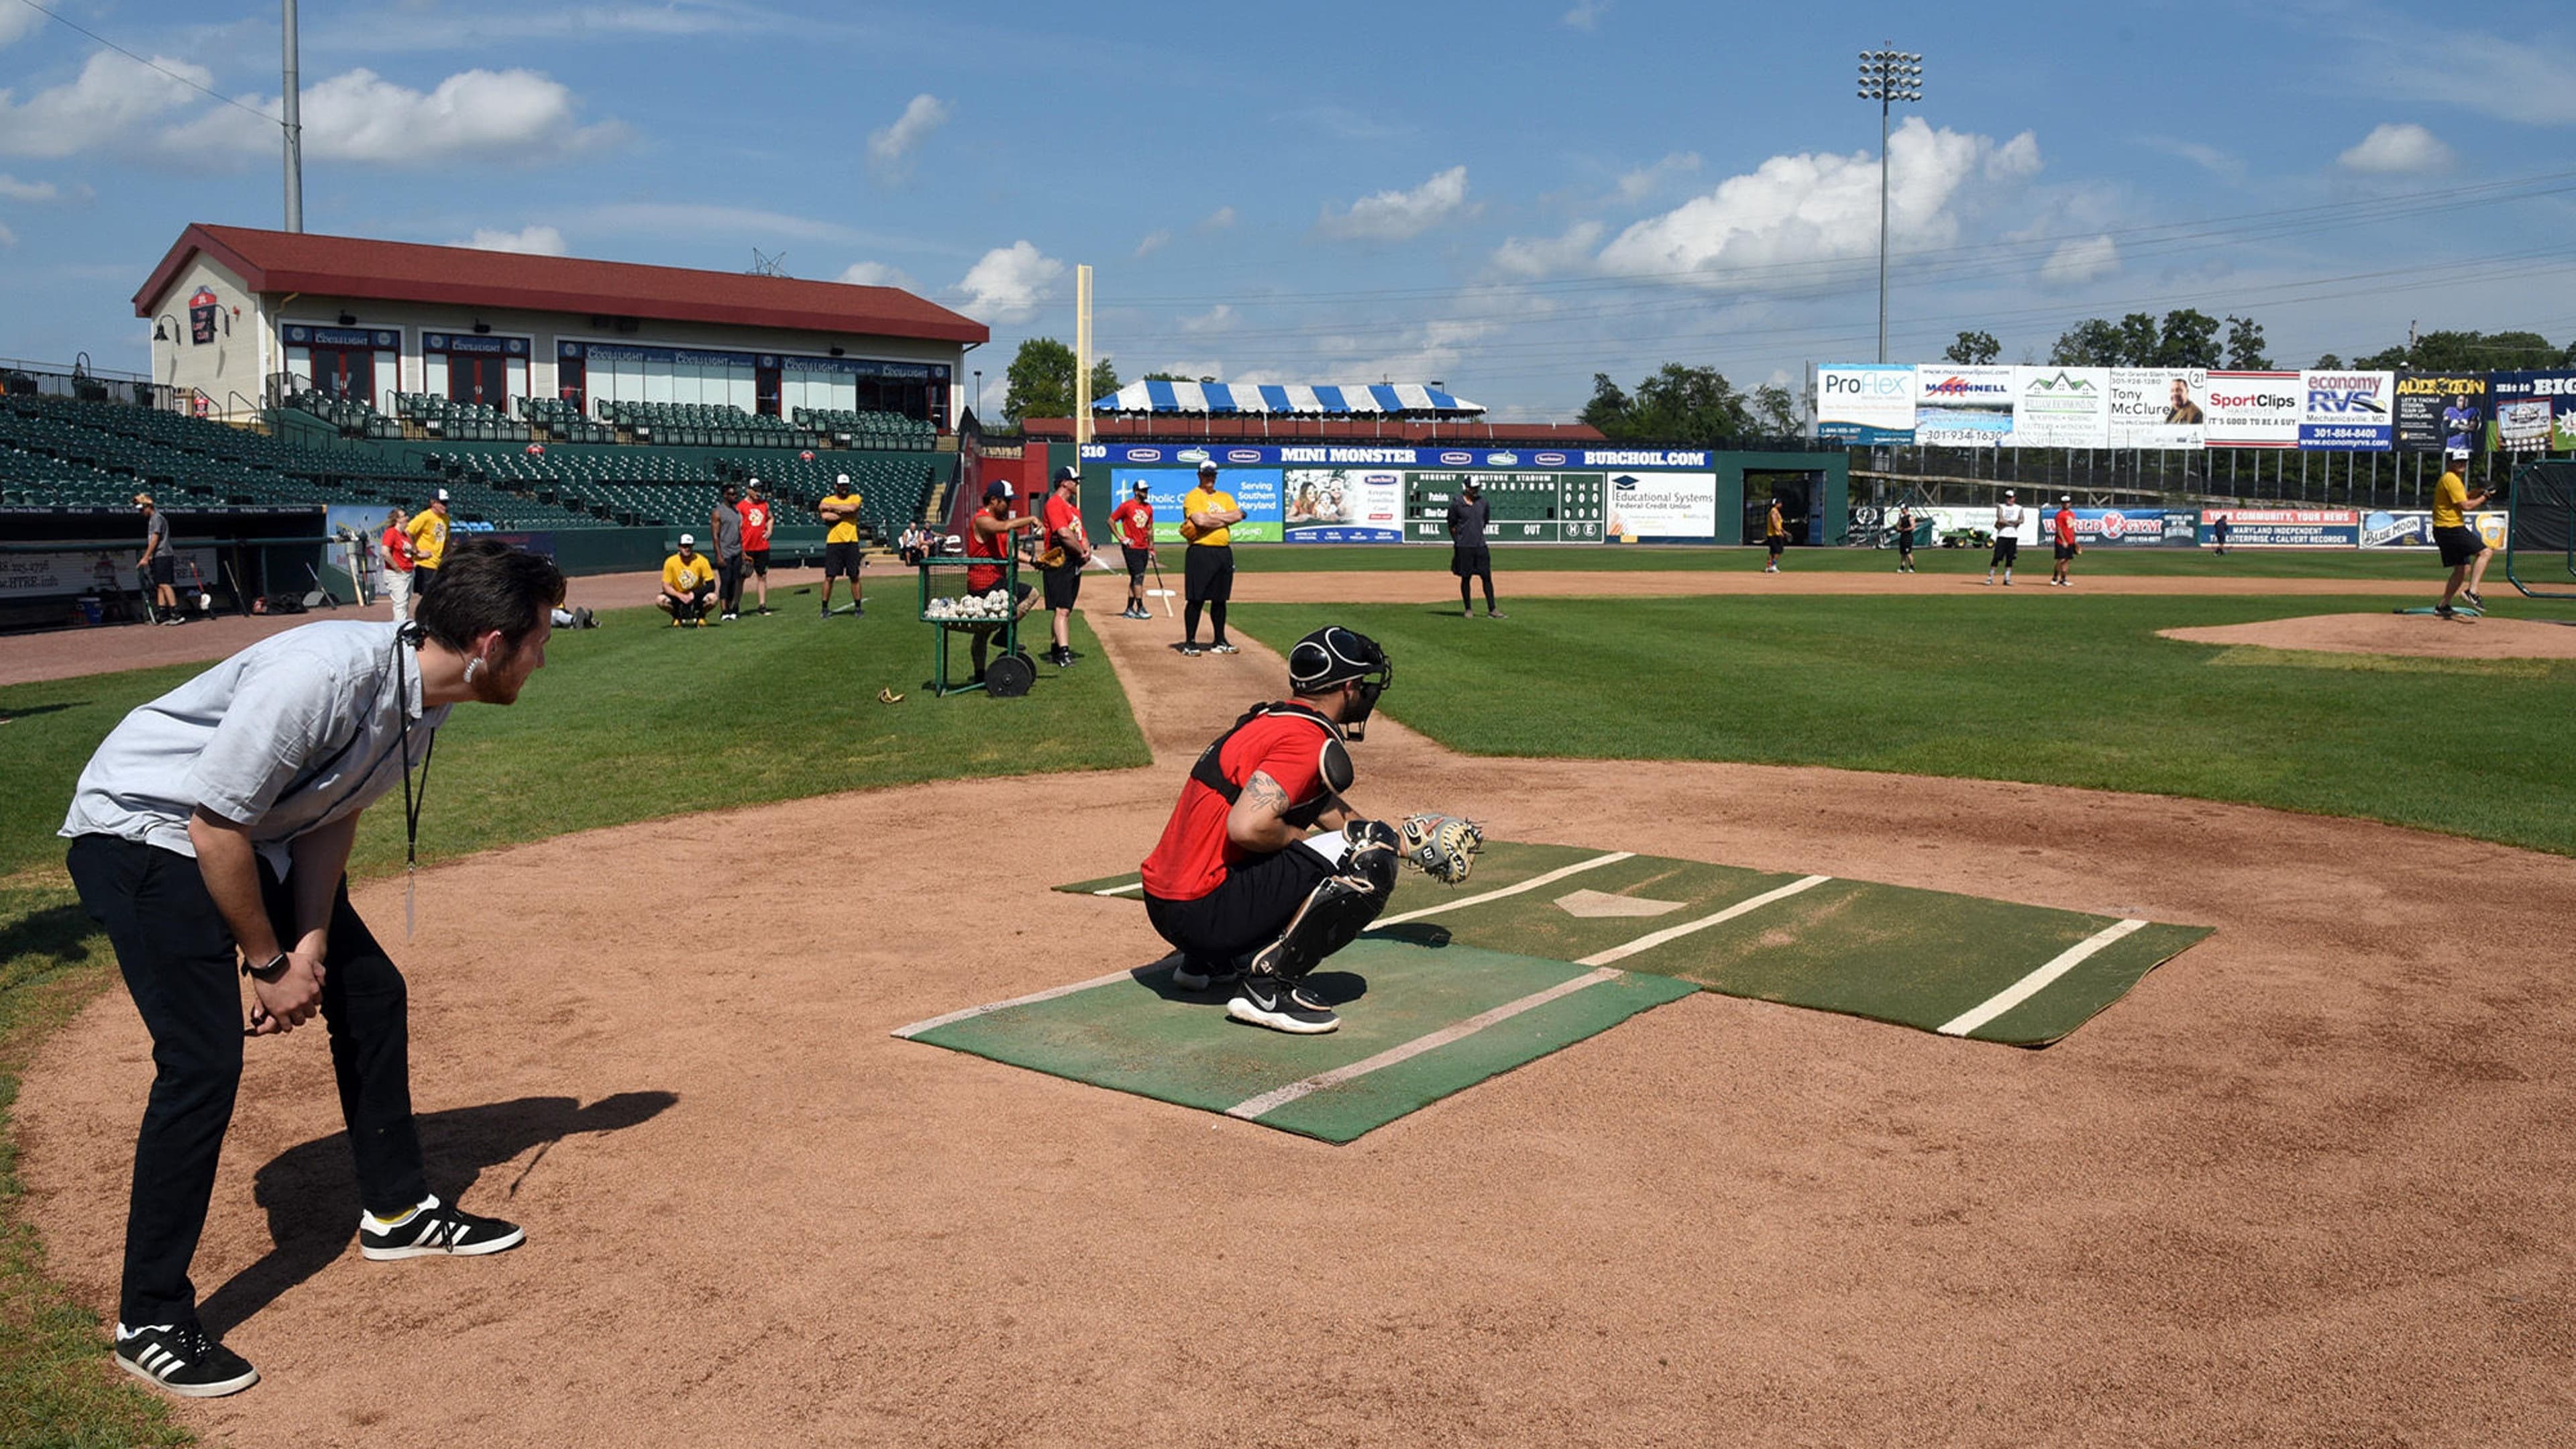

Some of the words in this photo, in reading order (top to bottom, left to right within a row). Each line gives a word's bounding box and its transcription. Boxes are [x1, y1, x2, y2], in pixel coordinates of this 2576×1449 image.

[2308, 376, 2383, 398] economy
[2496, 383, 2517, 392] Hit
[2519, 383, 2530, 392] it
[2112, 388, 2142, 401] Tony
[2112, 402, 2171, 415] McClure
[1927, 430, 2002, 441] 301-934-1630
[2300, 439, 2389, 447] www.economyrvs.com
[1081, 445, 1106, 458] 310
[1281, 447, 1326, 462] MINI
[1330, 449, 1417, 463] MONSTER
[1585, 451, 1705, 466] BURCHOIL.COM
[1241, 482, 1273, 492] Serving
[1413, 481, 1419, 489] P
[1491, 482, 1497, 490] 4
[1521, 482, 1525, 490] 7
[1565, 483, 1572, 491] R
[1592, 483, 1599, 491] E
[1238, 492, 1276, 500] Southern
[1565, 492, 1572, 503] 0
[1578, 492, 1585, 503] 0
[1592, 492, 1599, 503] 0
[1616, 491, 1672, 502] Educational
[1674, 493, 1713, 504] Systems
[1238, 501, 1276, 511] Maryland
[1578, 508, 1585, 518] 0
[1592, 508, 1599, 518] 0
[2237, 511, 2294, 522] COMMUNITY,
[2297, 512, 2321, 521] YOUR
[2323, 512, 2350, 521] NEWS
[1419, 524, 1440, 534] BALL
[1523, 524, 1541, 535] OUT
[2043, 519, 2102, 534] WRLD
[2125, 519, 2163, 534] GYM
[2274, 527, 2323, 535] INDEPENDENT
